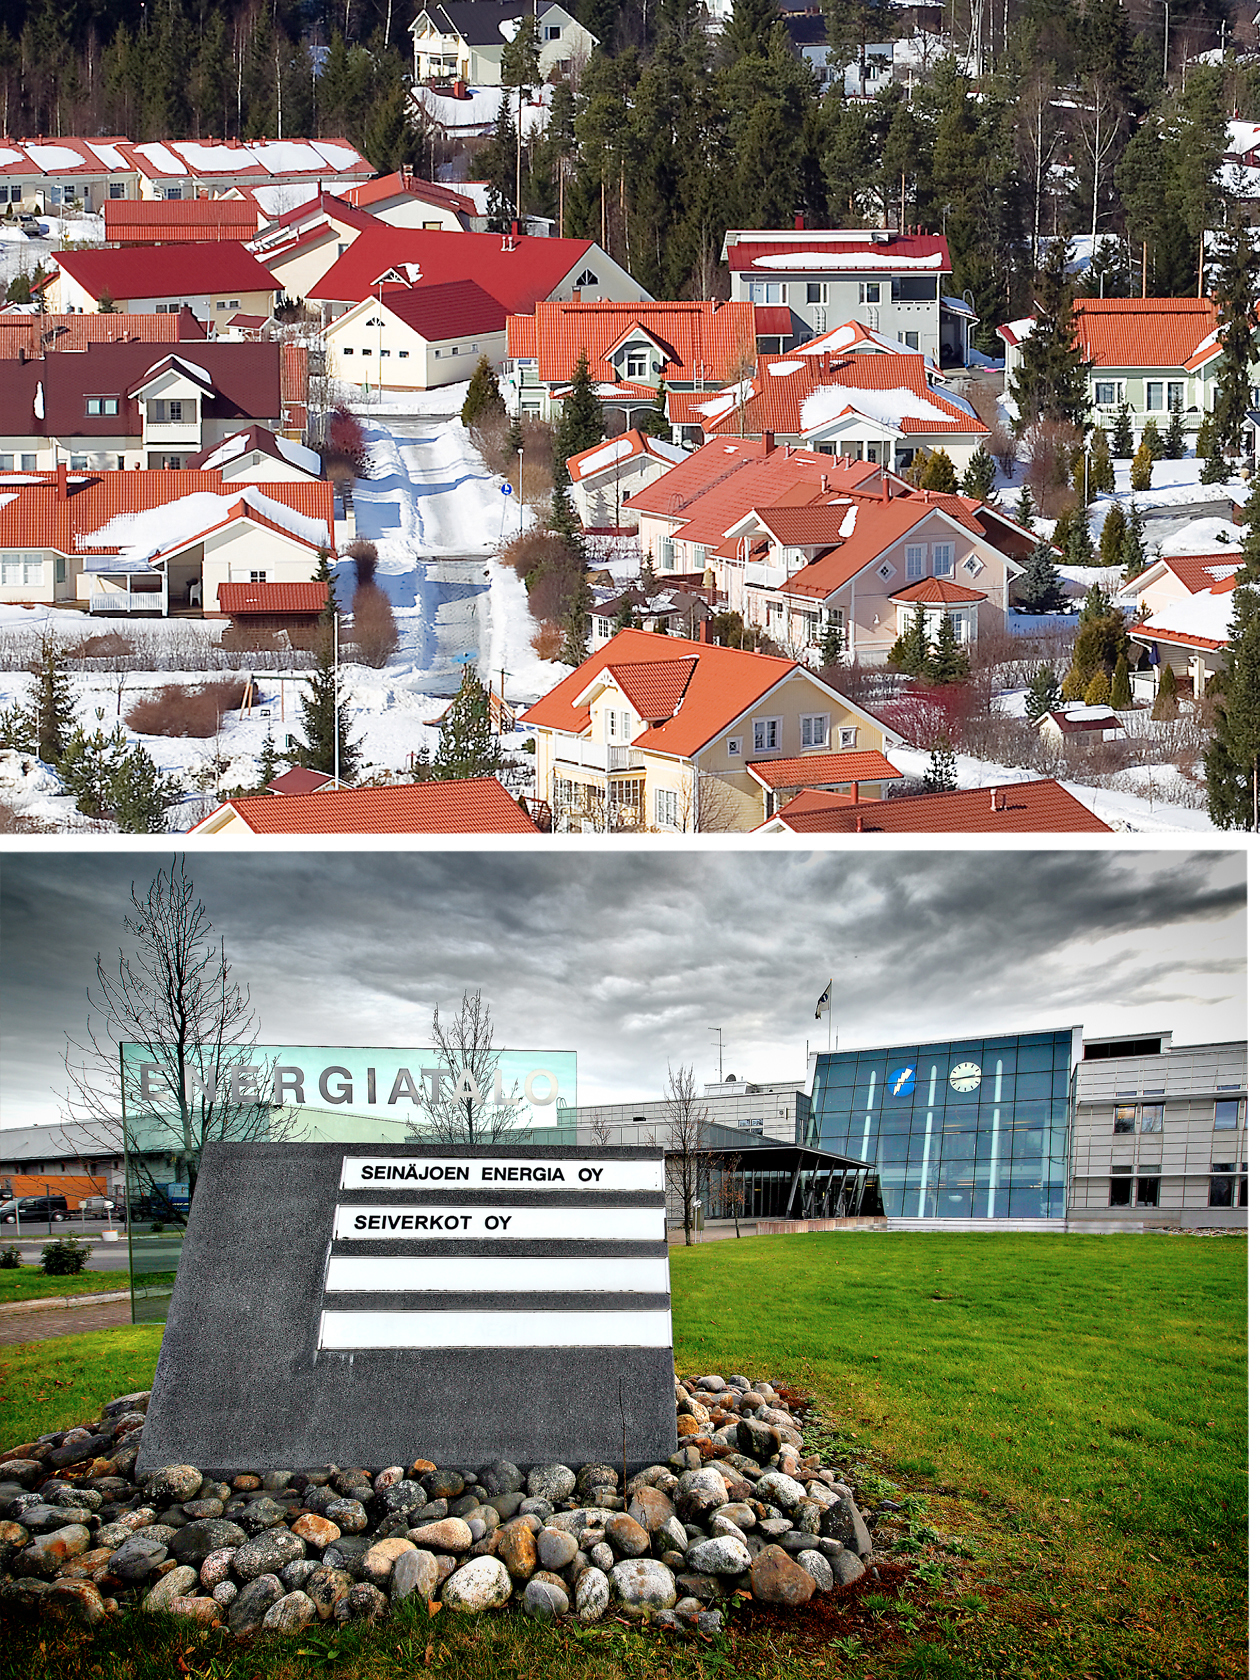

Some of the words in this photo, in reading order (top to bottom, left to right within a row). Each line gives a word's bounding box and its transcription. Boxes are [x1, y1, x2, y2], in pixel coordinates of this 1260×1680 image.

[140, 1064, 559, 1106] ENERGIATALO
[361, 1164, 470, 1180] SEINÄJOEN
[481, 1167, 565, 1181] ENERGIA
[578, 1168, 603, 1182] OY
[354, 1215, 472, 1230] SEIVERKOT
[484, 1215, 512, 1230] OY
